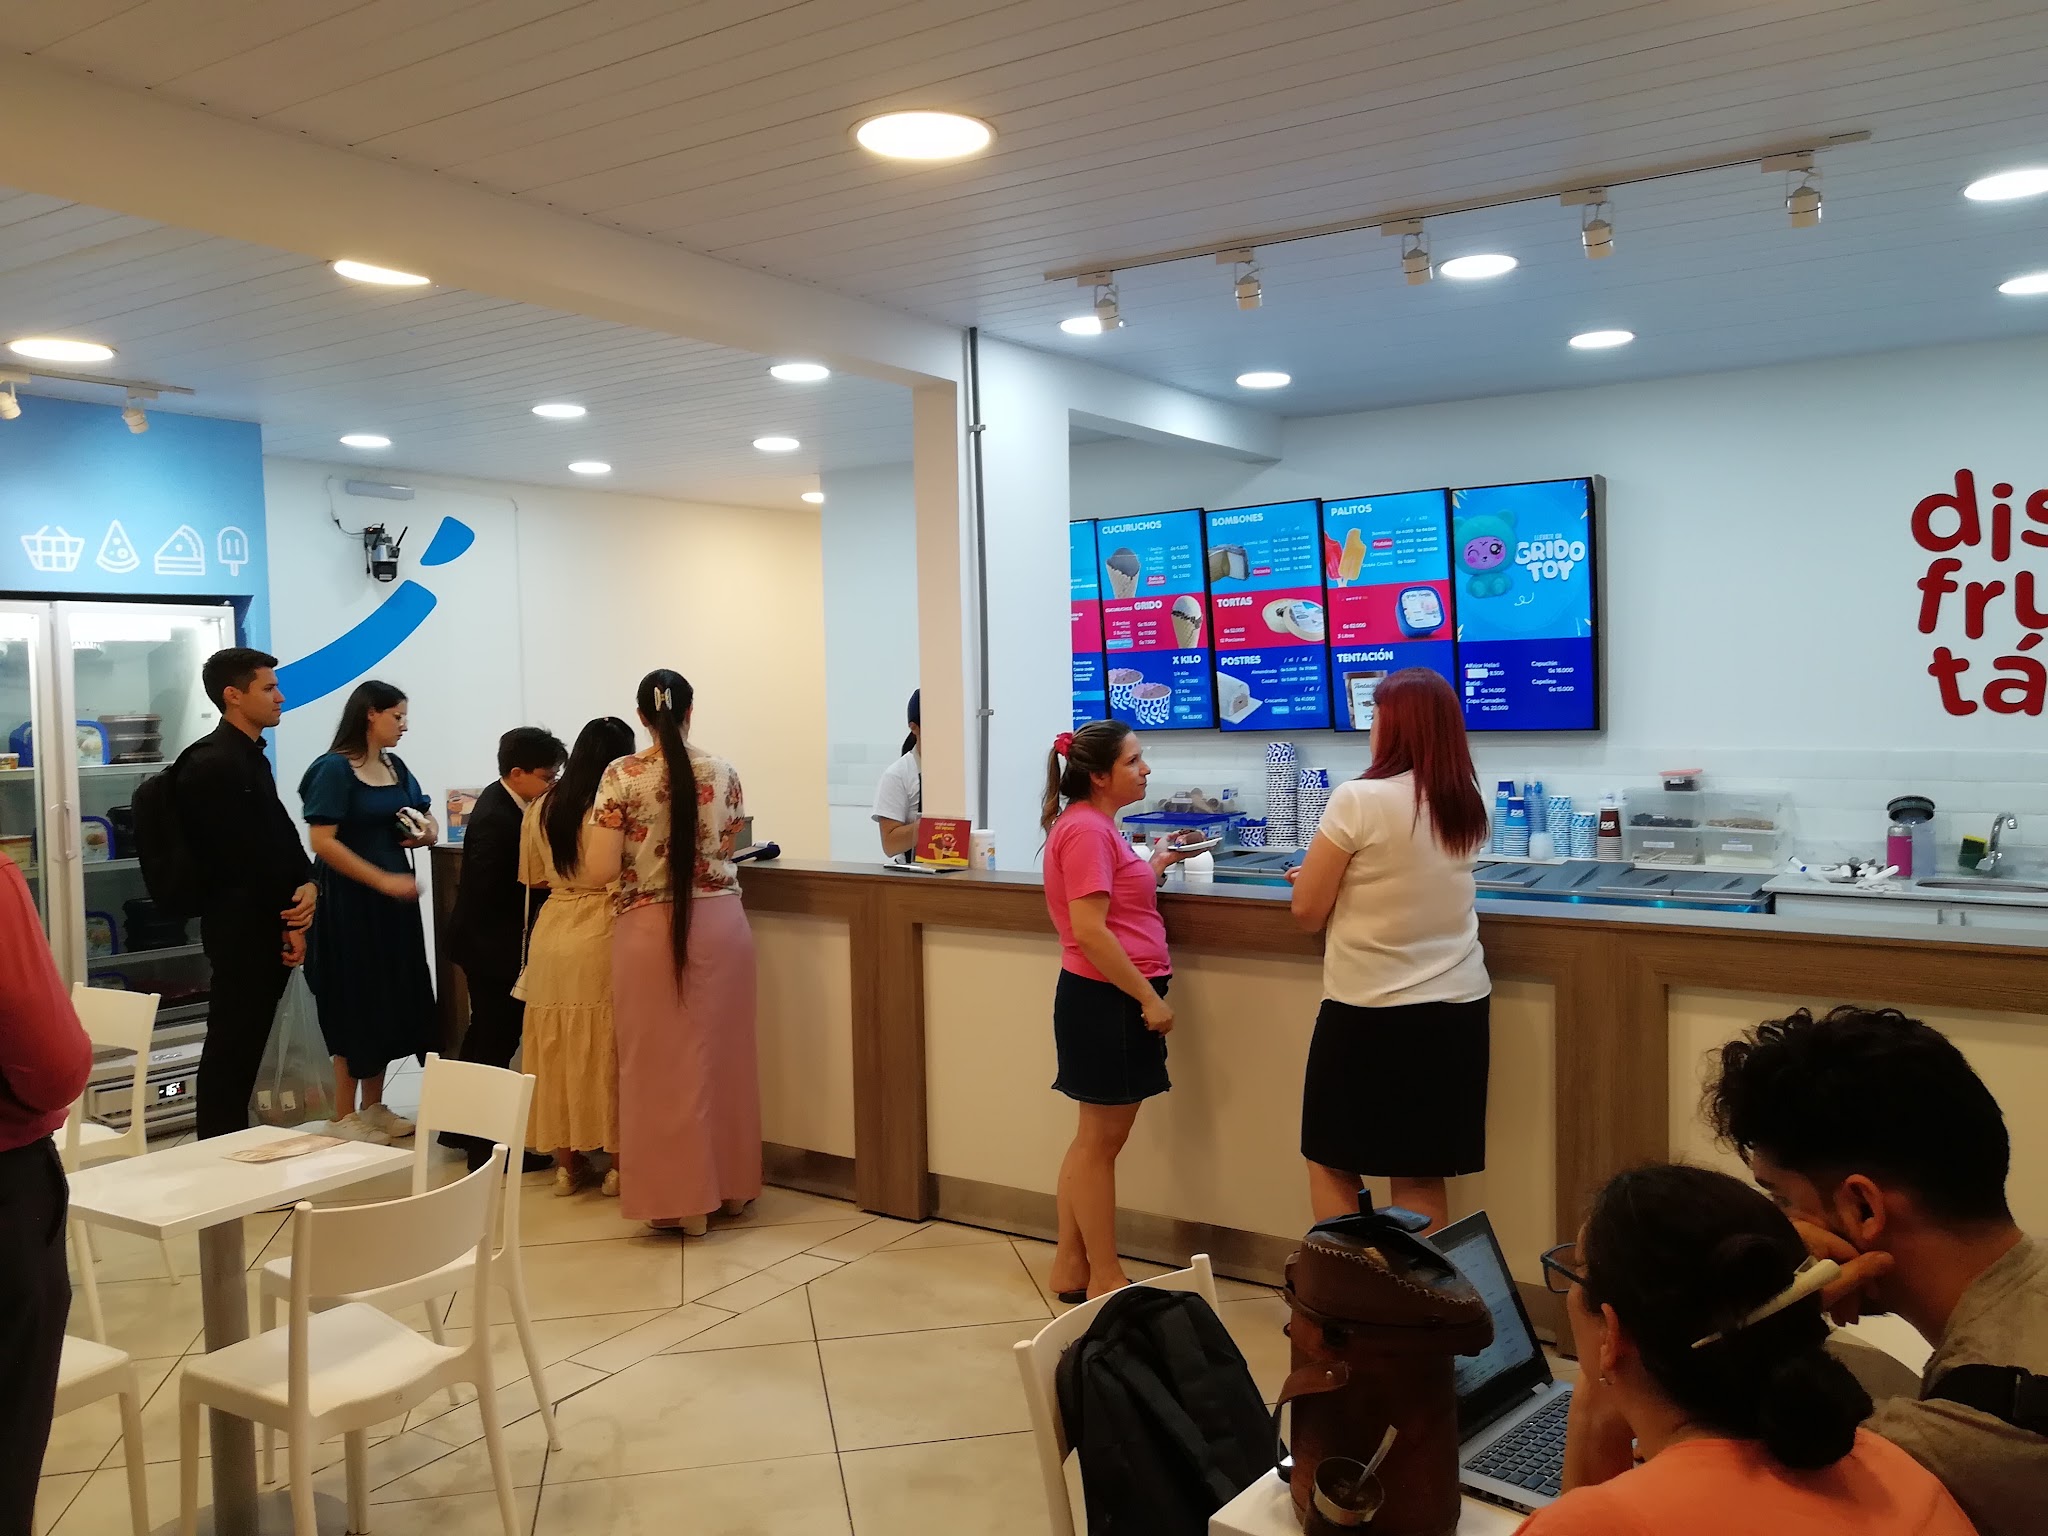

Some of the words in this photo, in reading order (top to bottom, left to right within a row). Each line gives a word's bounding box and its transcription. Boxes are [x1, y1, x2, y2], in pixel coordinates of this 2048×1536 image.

[1331, 504, 1372, 516] PALITOS
[1911, 468, 2048, 562] dis
[1212, 513, 1263, 526] BOMBONES
[1102, 521, 1161, 534] CUCURUCHOS
[1515, 539, 1585, 564] GRIDO
[1527, 560, 1574, 581] TOY
[1134, 600, 1162, 610] GRIDO
[1217, 597, 1253, 608] TORTAS
[1172, 656, 1179, 665] X
[1180, 655, 1201, 664] KILO
[1221, 655, 1261, 666] POSTRES
[1336, 648, 1394, 663] TENTACIÓN
[1928, 632, 2047, 716] tá
